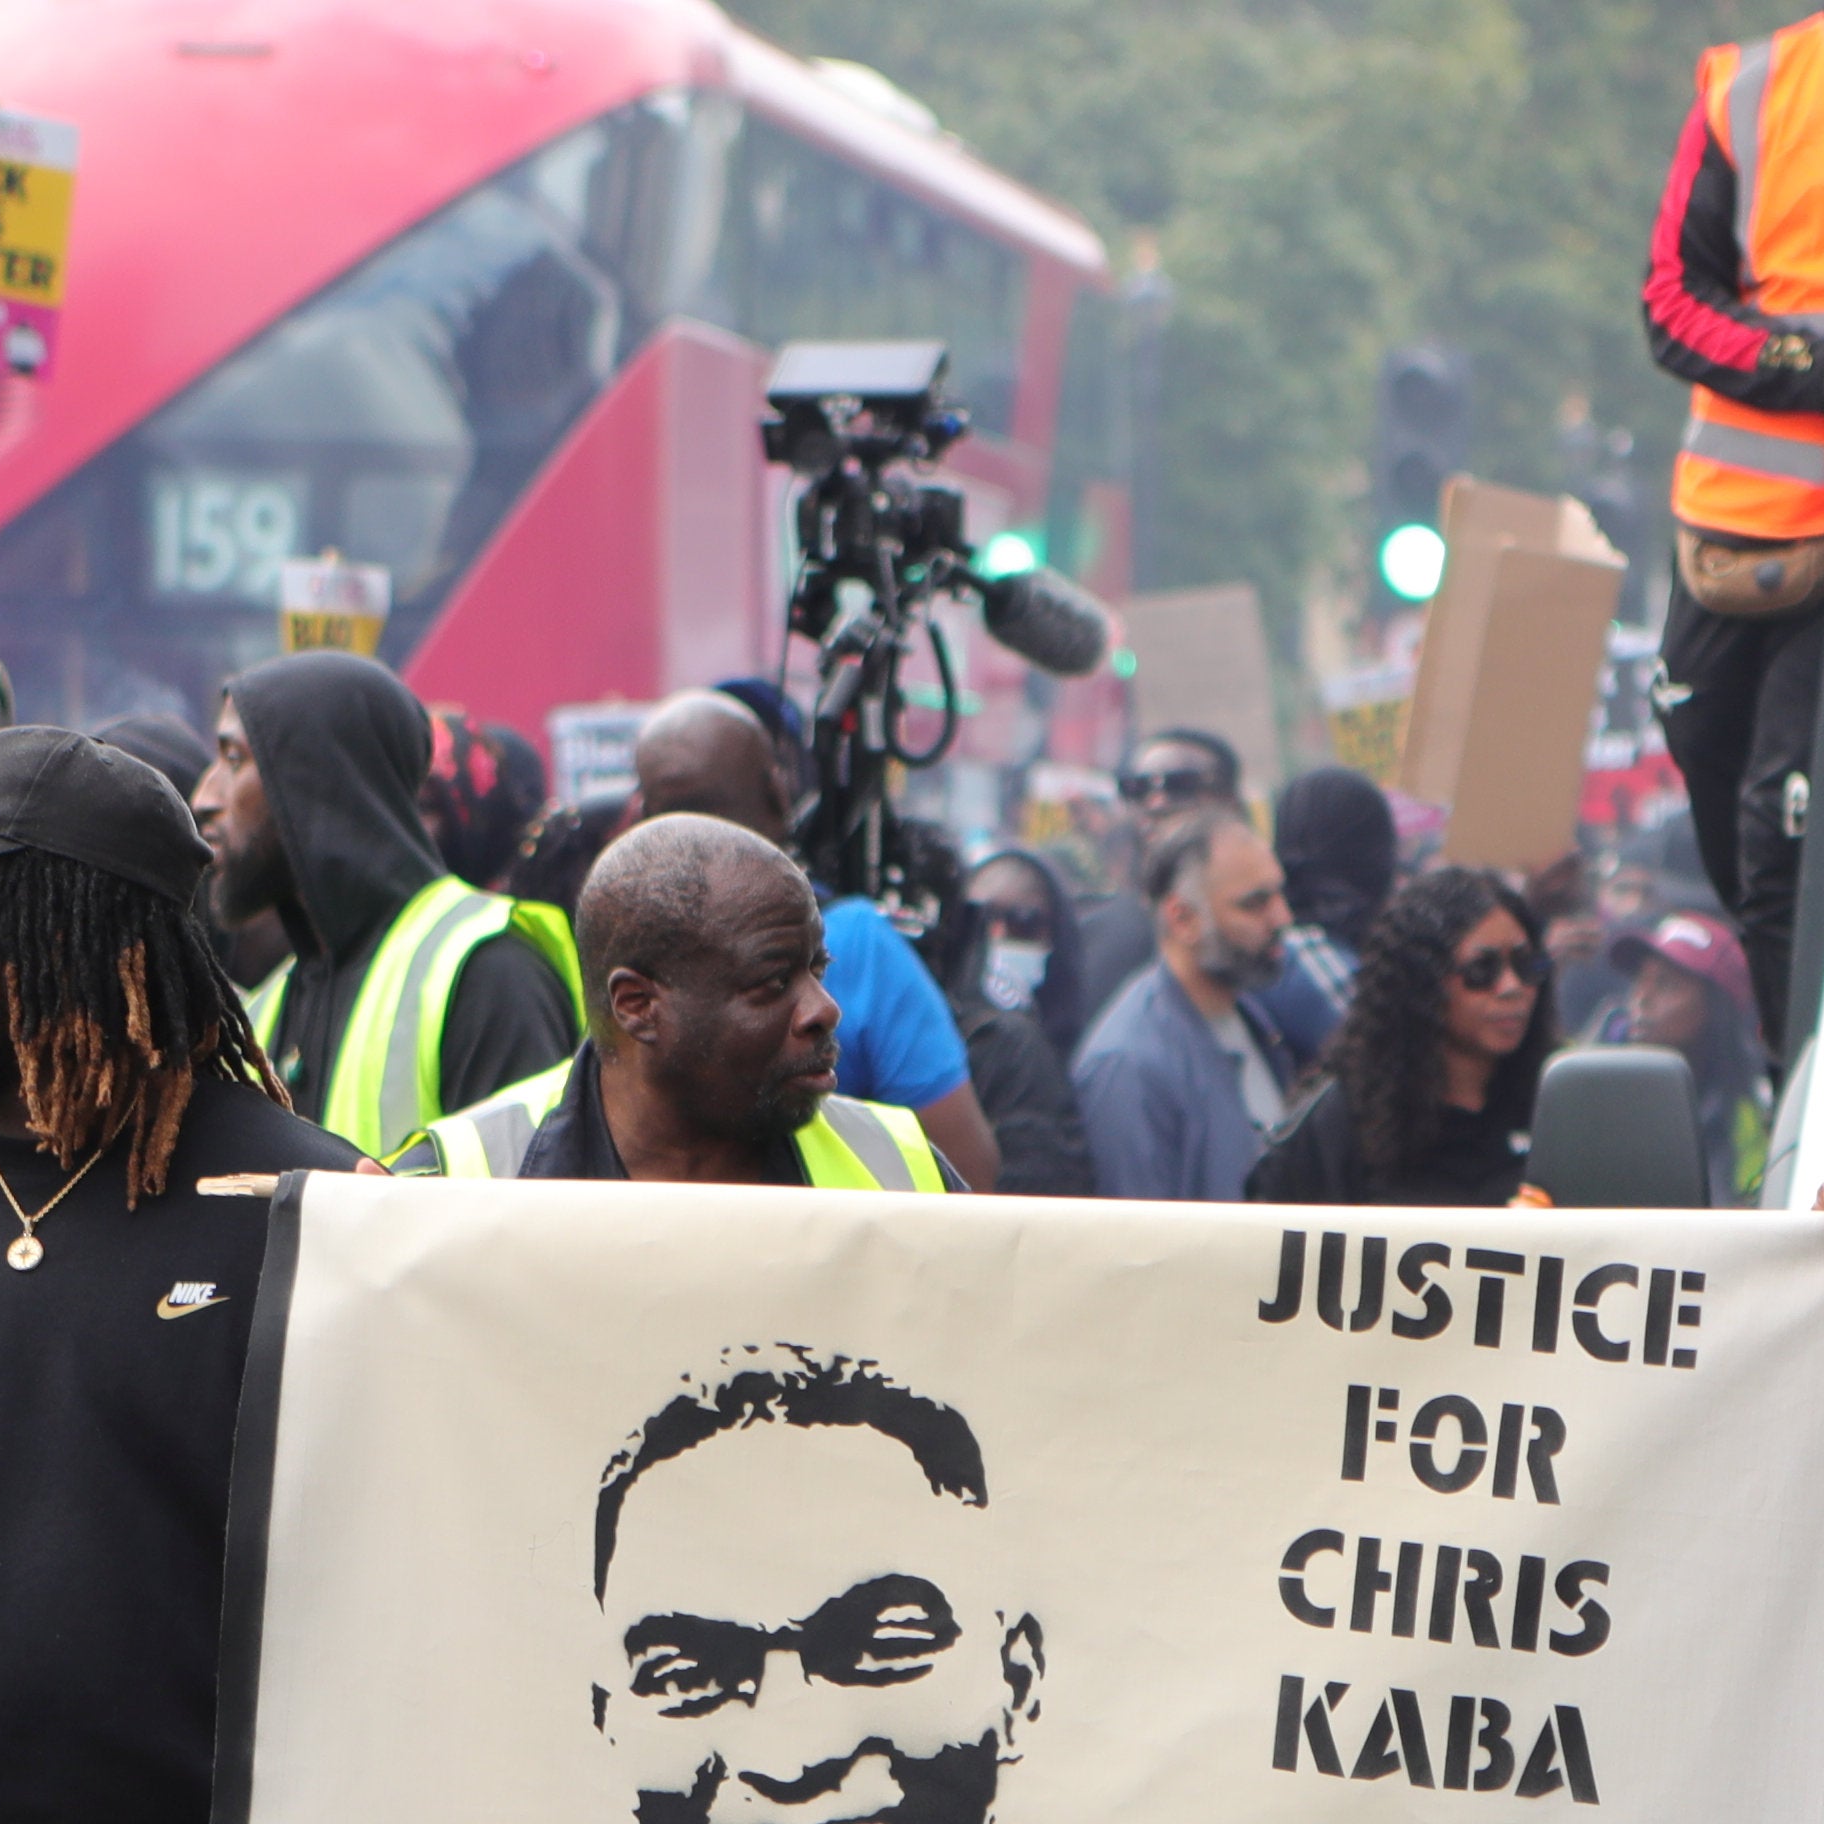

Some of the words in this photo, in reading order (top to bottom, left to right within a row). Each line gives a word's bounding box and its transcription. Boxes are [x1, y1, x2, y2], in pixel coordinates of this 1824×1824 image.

[154, 485, 296, 604] 159
[291, 613, 353, 648] BLAC
[168, 1281, 217, 1305] NIKE
[1257, 1228, 1707, 1371] JUSTICE
[1340, 1383, 1568, 1506] FOR
[1277, 1527, 1612, 1658] CHRIS
[1271, 1672, 1601, 1806] KABA
